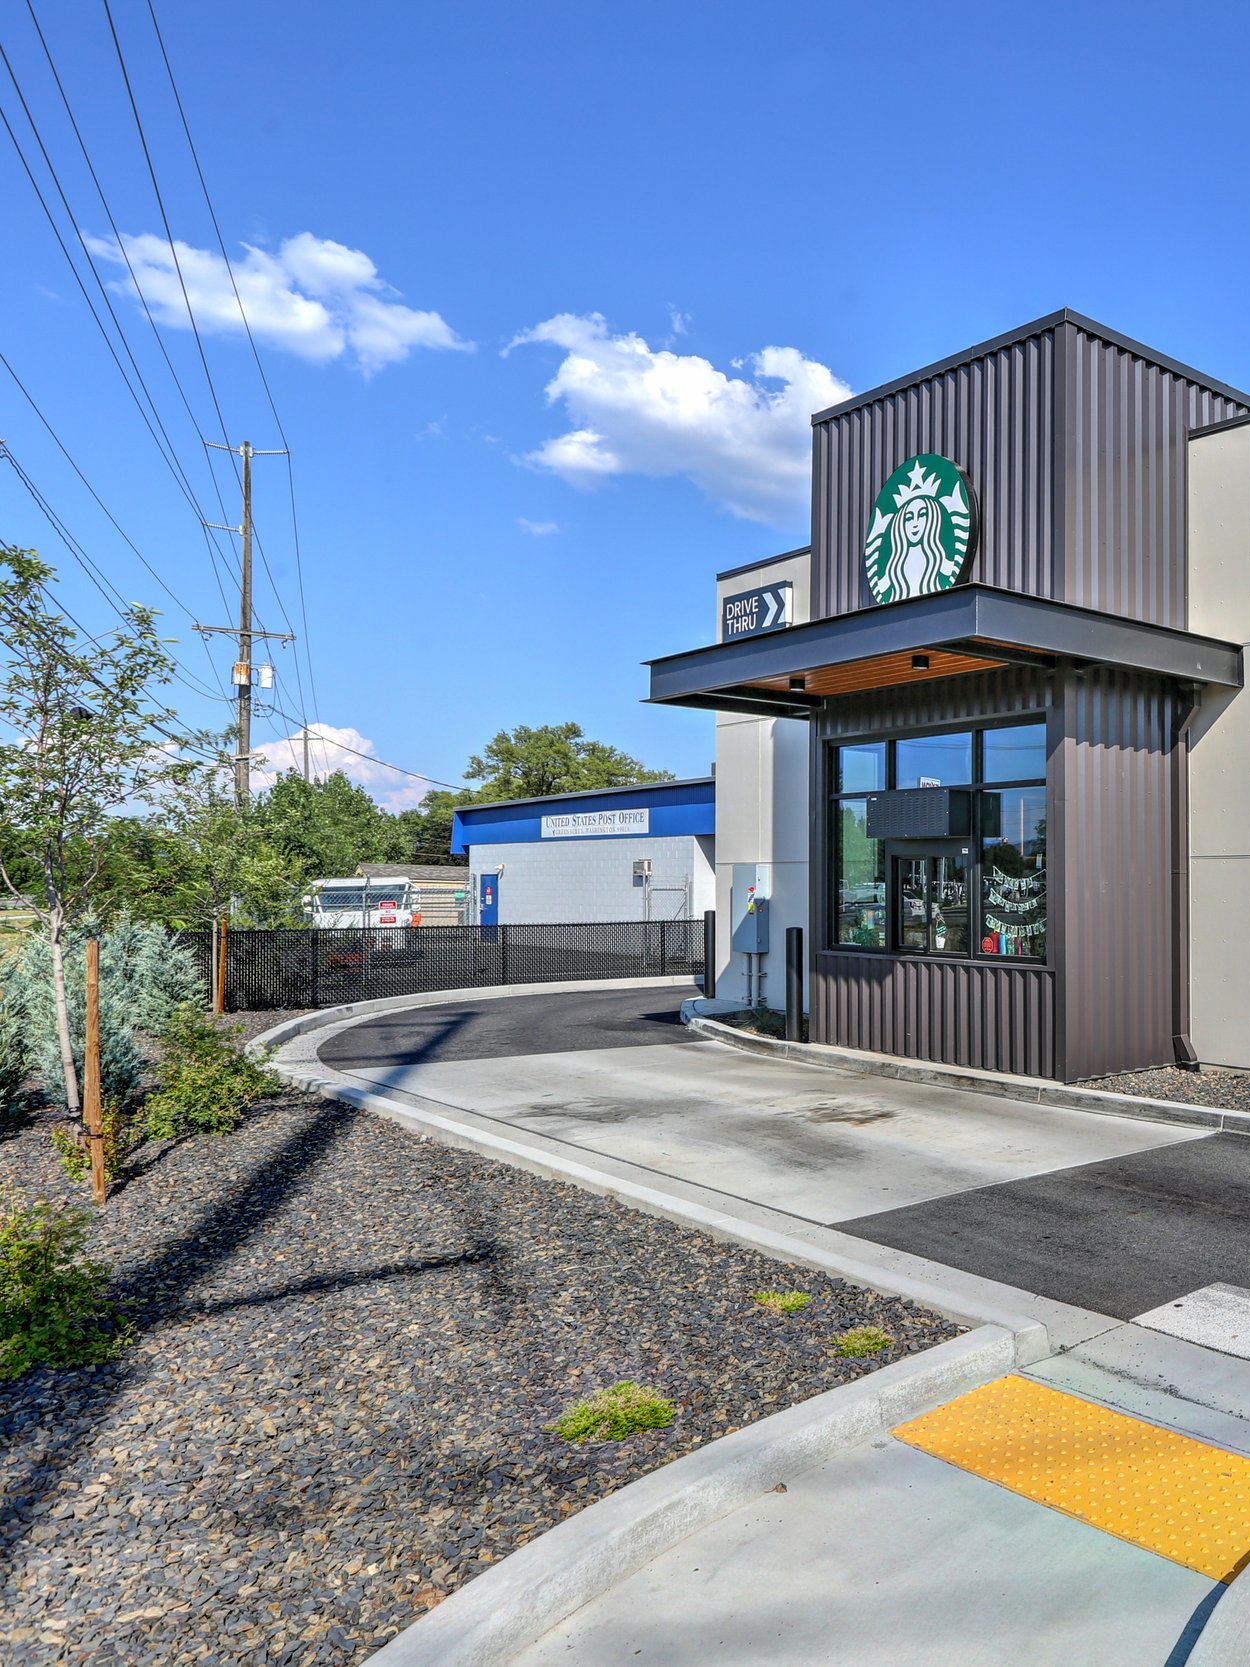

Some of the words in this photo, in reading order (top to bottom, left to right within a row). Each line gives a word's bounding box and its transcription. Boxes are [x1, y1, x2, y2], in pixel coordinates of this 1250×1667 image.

[726, 596, 759, 620] DRIVE
[726, 613, 757, 635] THRU
[572, 814, 597, 827] STATES
[598, 812, 617, 825] POST
[618, 811, 645, 824] OFFICE
